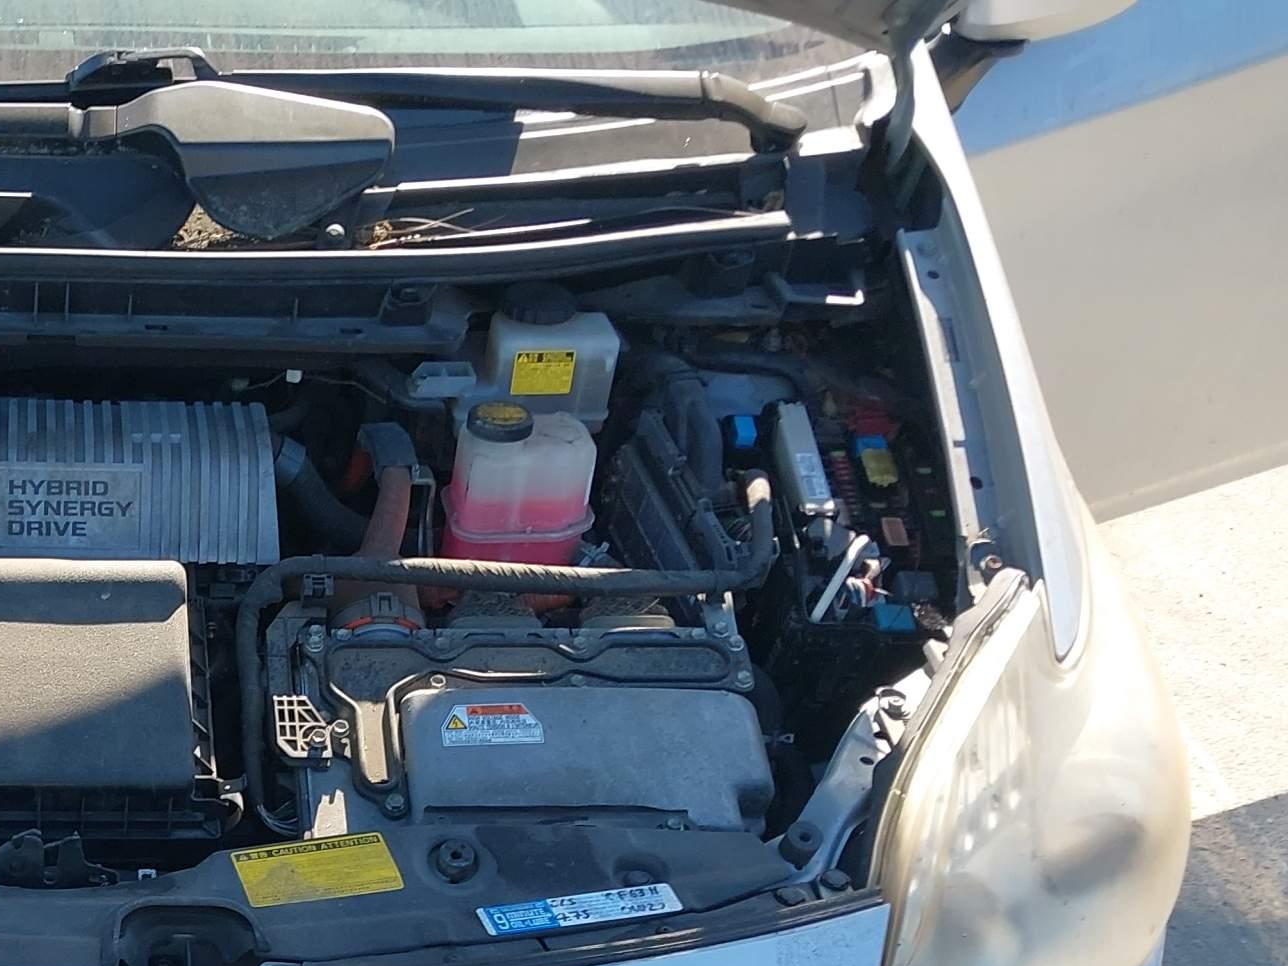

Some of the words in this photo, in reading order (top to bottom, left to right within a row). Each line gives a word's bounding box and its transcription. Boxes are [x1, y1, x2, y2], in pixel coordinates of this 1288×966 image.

[8, 479, 109, 497] HYBRID
[7, 499, 134, 517] SYNERGY
[7, 520, 87, 537] DRIVE
[271, 843, 317, 858] CAUTION
[320, 836, 379, 851] ATTENTION
[493, 912, 510, 930] 9
